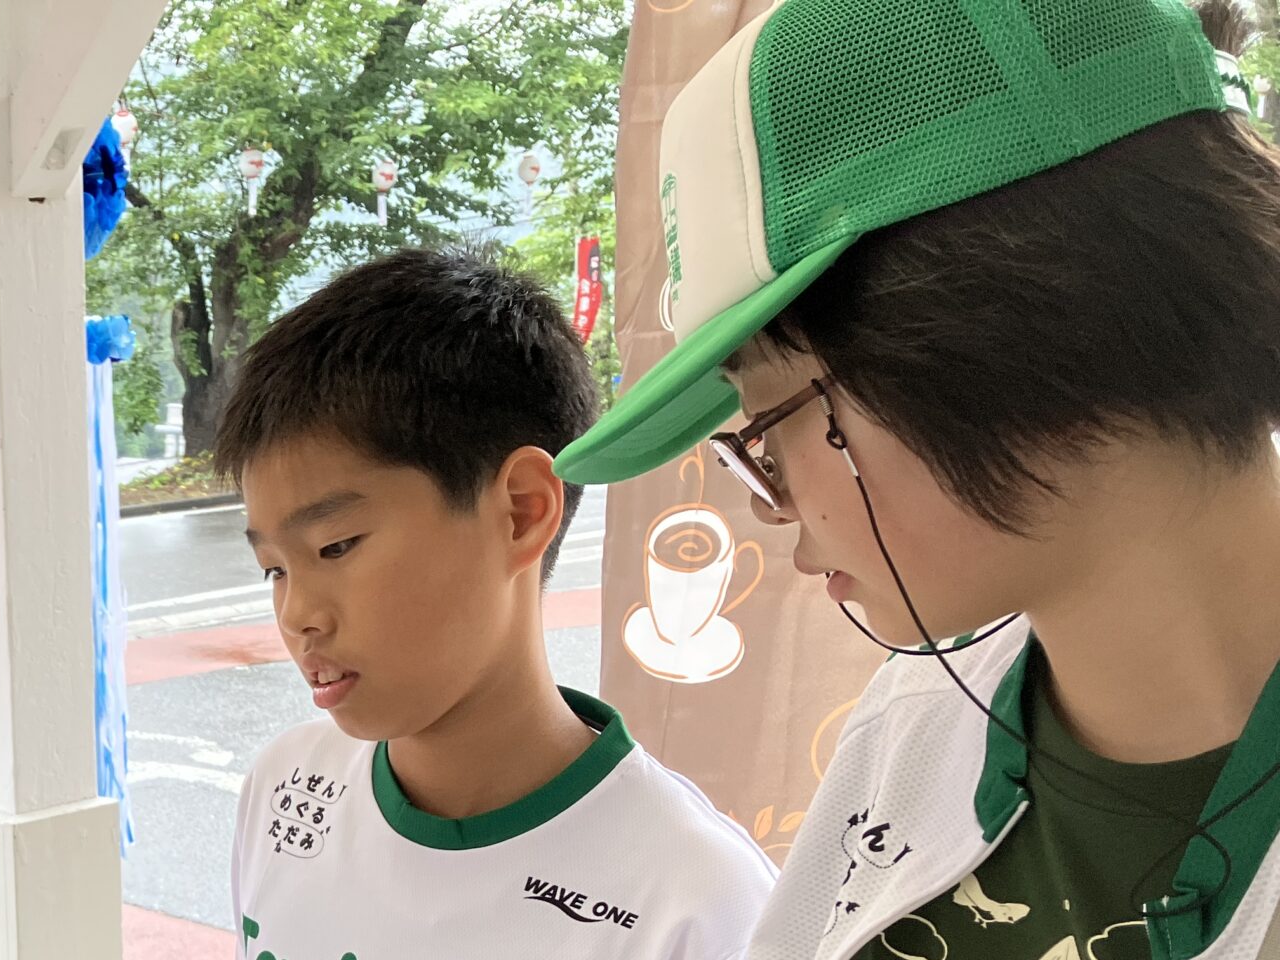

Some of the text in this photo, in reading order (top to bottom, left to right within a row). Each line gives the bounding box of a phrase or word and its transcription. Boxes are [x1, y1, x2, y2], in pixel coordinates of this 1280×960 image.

[280, 794, 325, 825] めぐる
[268, 818, 314, 850] ただみ
[524, 876, 639, 929] WAVE ONE
